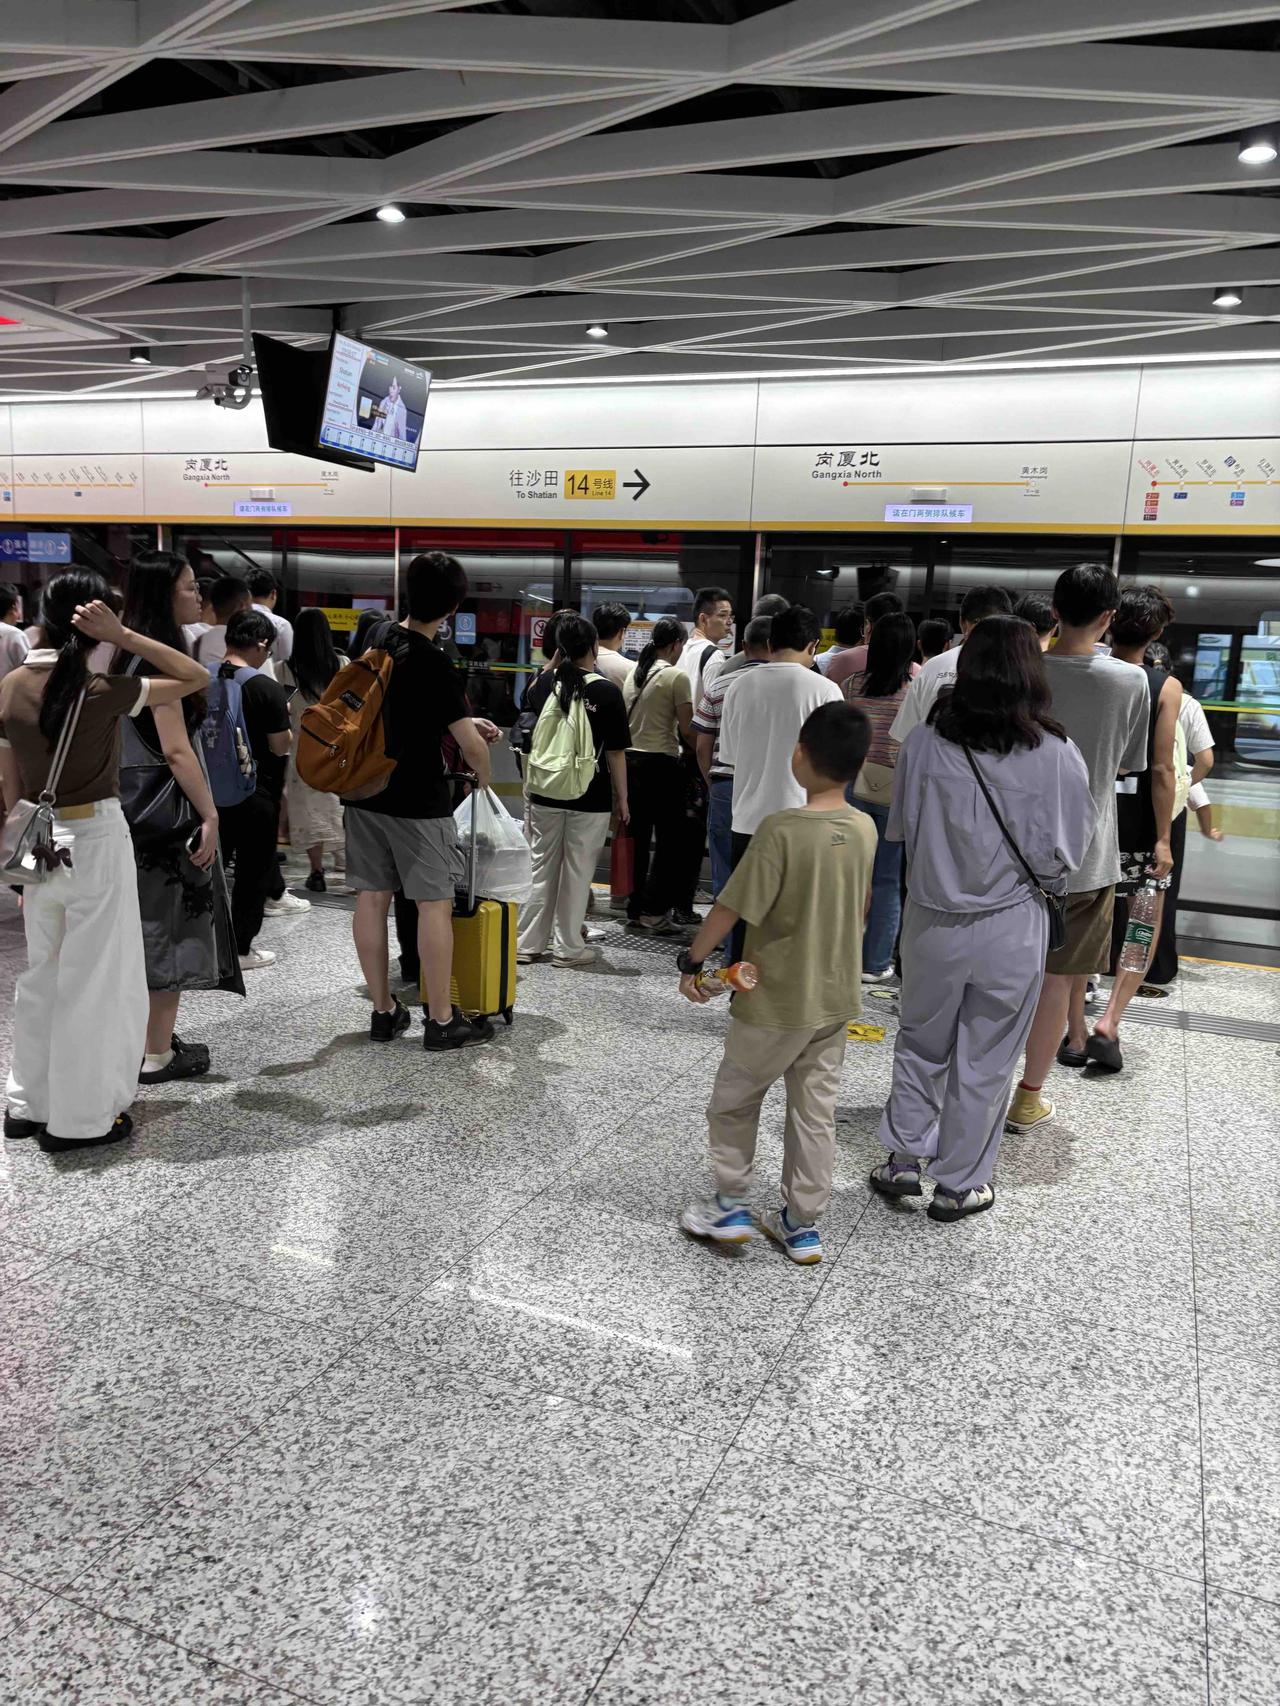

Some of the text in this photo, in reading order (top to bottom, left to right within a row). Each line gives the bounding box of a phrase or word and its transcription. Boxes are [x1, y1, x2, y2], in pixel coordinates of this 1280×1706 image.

[184, 457, 229, 472] 岗厦北
[814, 450, 881, 468] 岗厦北
[183, 473, 231, 482] Gangxia North
[508, 470, 558, 487] 往沙田
[812, 469, 882, 480] Gangxia North
[567, 474, 590, 496] 14
[592, 478, 614, 490] 号线
[516, 490, 557, 499] To Shatian
